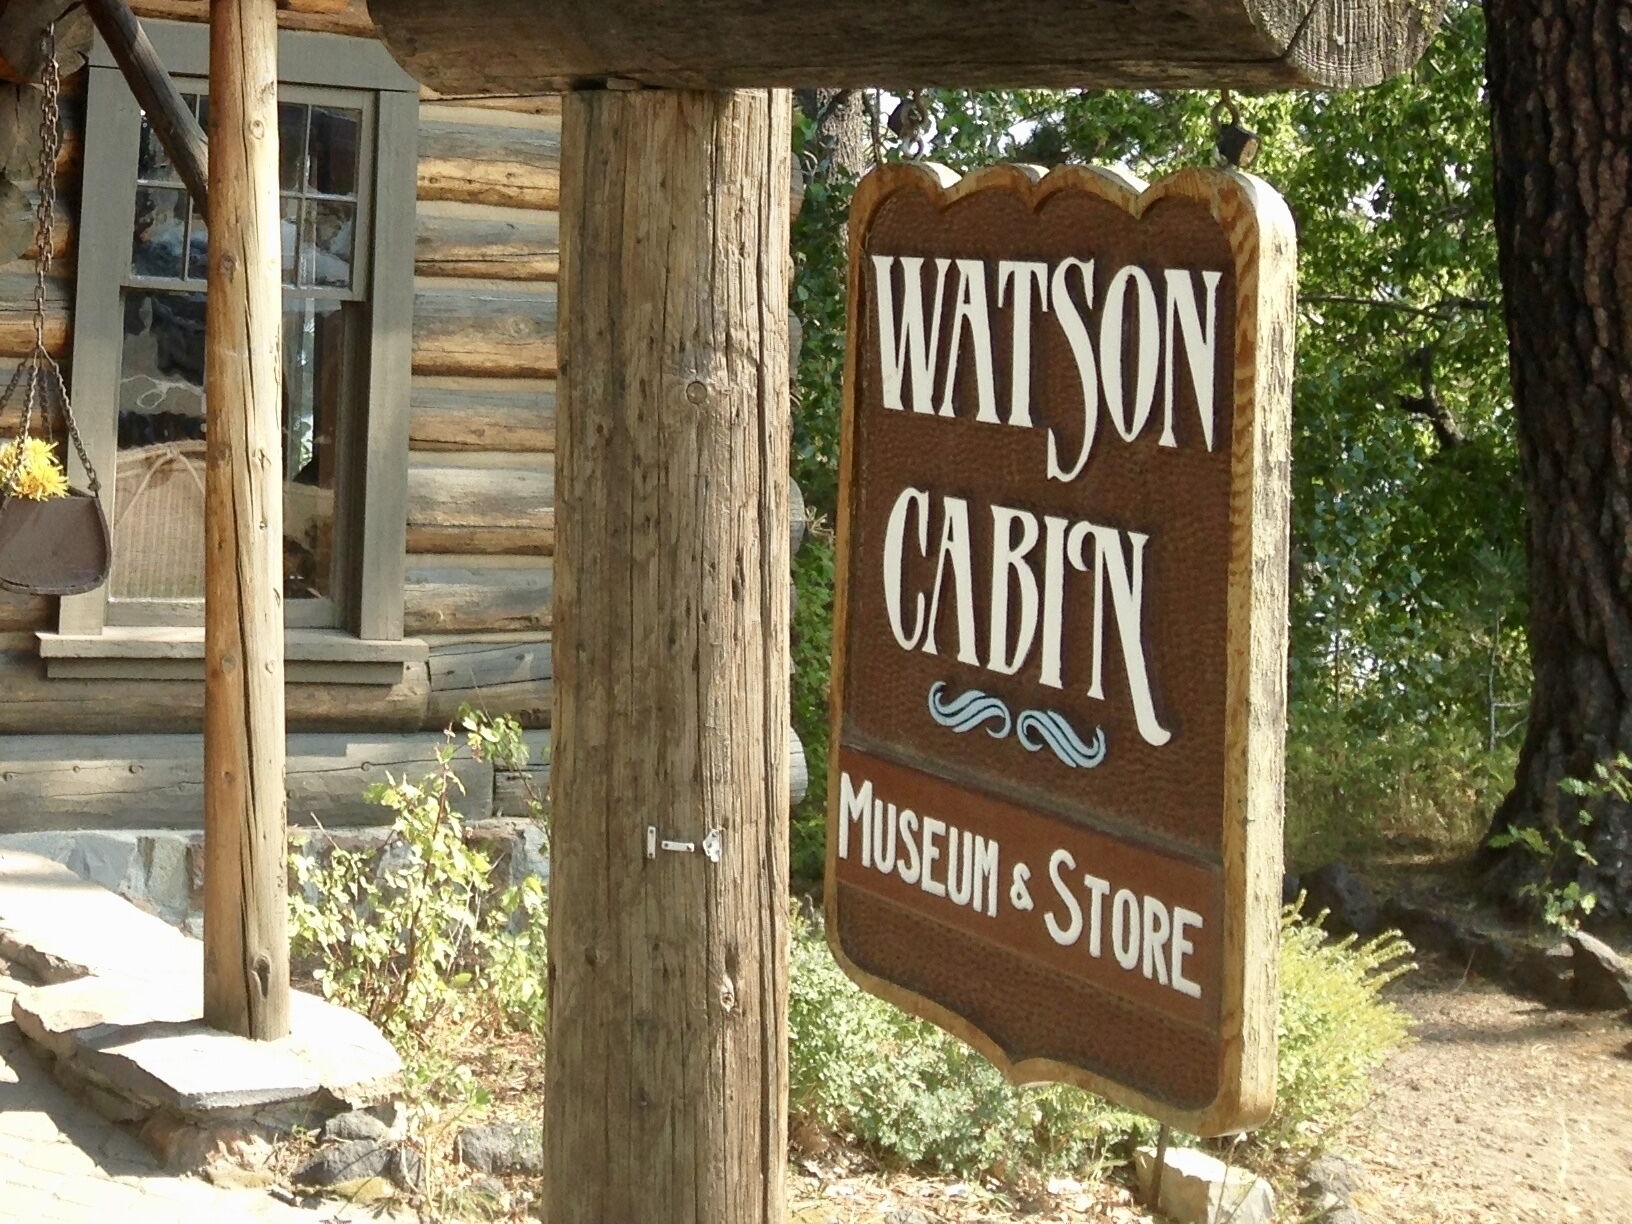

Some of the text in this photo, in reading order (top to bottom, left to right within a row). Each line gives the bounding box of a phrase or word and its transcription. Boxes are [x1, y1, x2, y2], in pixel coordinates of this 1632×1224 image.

[871, 254, 1223, 483] WATSON
[882, 486, 1173, 747] CABIN
[838, 772, 1204, 999] MUSEUM & STORE
